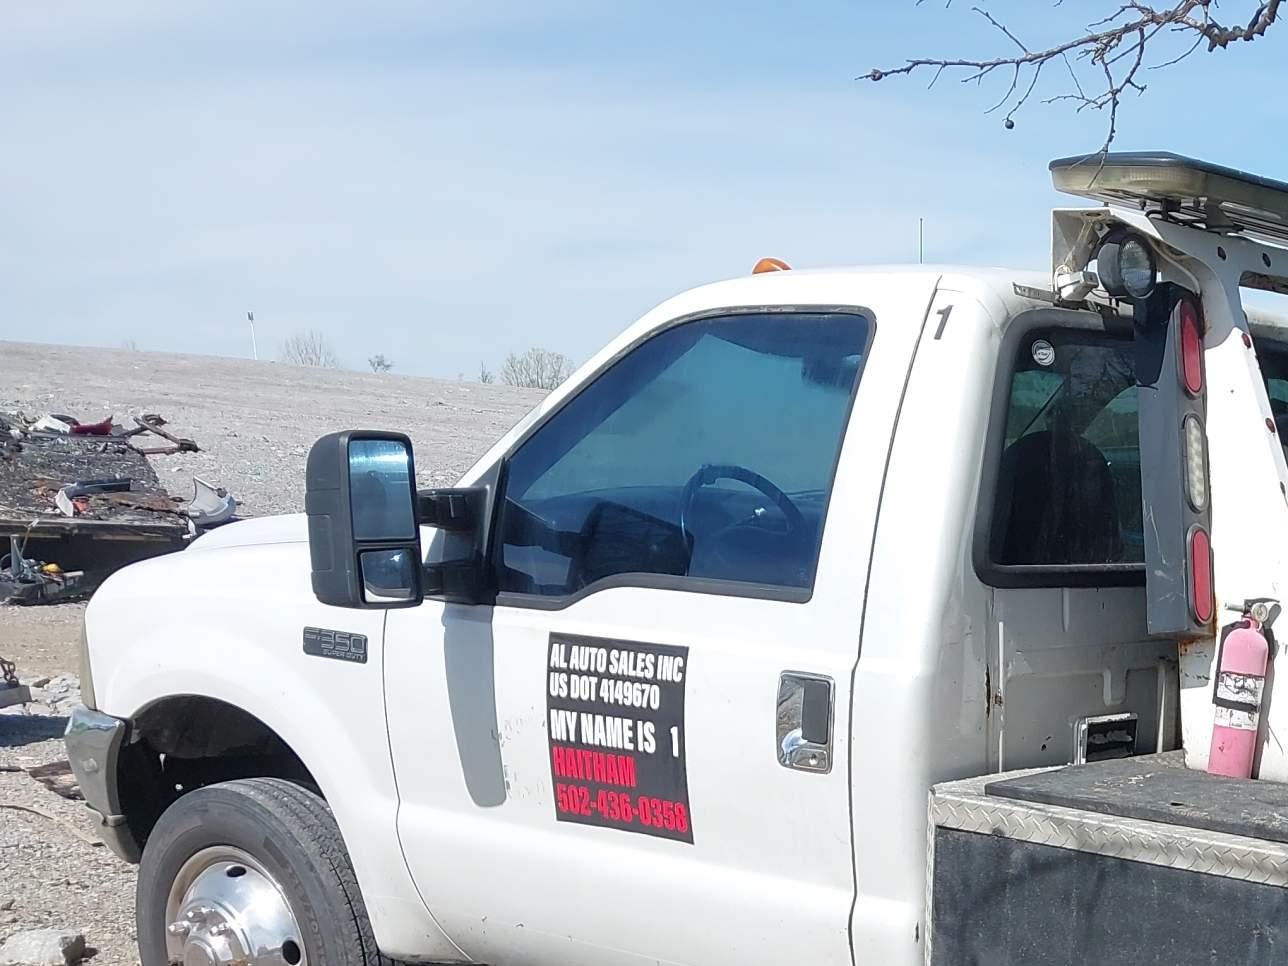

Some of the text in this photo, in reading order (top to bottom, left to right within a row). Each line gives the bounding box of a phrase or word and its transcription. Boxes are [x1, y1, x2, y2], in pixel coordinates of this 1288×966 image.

[550, 643, 684, 682] AL AUTO SALES INC
[550, 672, 660, 710] US DOT 4149670
[550, 709, 679, 758] MY NAME IS 1
[552, 746, 637, 788] HAITHAM
[556, 784, 689, 833] 502-436-0358
